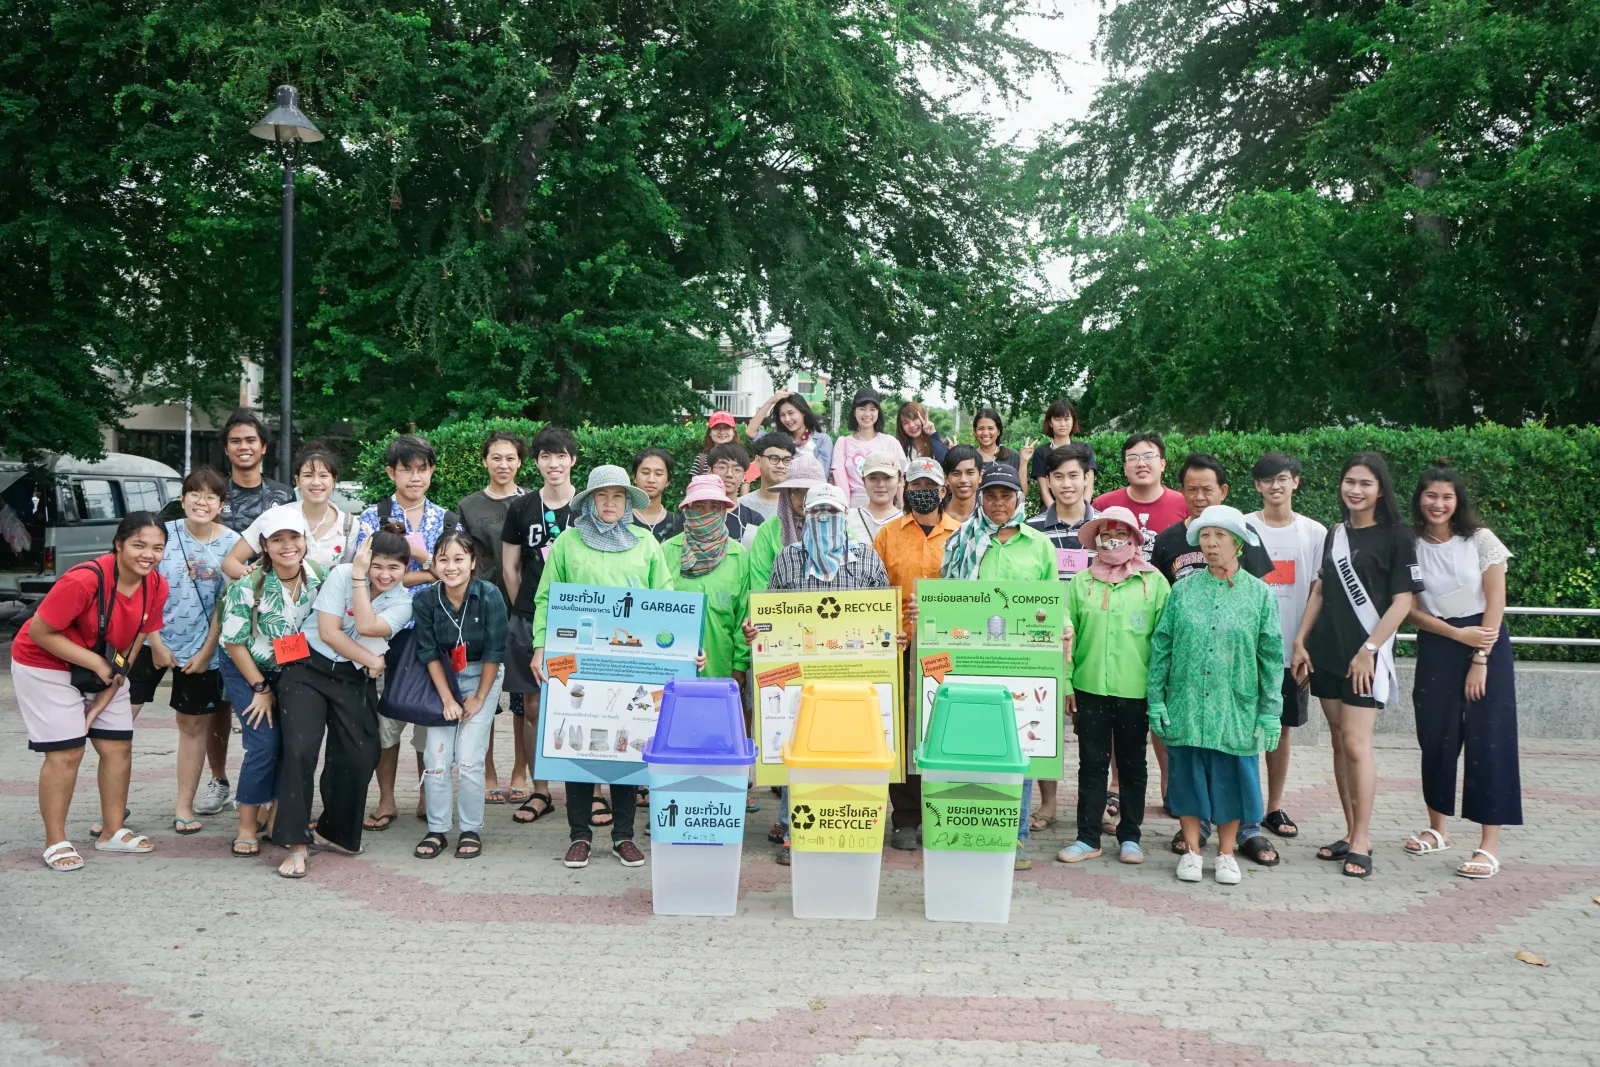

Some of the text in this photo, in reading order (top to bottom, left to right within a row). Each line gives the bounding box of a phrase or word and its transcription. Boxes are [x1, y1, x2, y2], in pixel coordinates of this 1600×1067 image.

[1337, 556, 1367, 607] THAILAND
[559, 590, 605, 604] ขยะทั่วไป
[921, 592, 991, 603] ขยะย่อยสลายได้
[1012, 595, 1060, 605] COMPOST
[641, 601, 695, 614] GARBAGE
[757, 602, 813, 616] ขยะรีไซเคิล
[844, 602, 892, 613] RECYCLE
[685, 801, 731, 816] ขยะทั่วไป
[819, 804, 878, 818] ขยะรีไซเคิล
[947, 806, 1018, 816] ขยะเศษอาหาร
[684, 817, 741, 828] GARBAGE
[819, 819, 872, 830] RECYCLE
[946, 816, 1018, 828] FOOD WASTE
